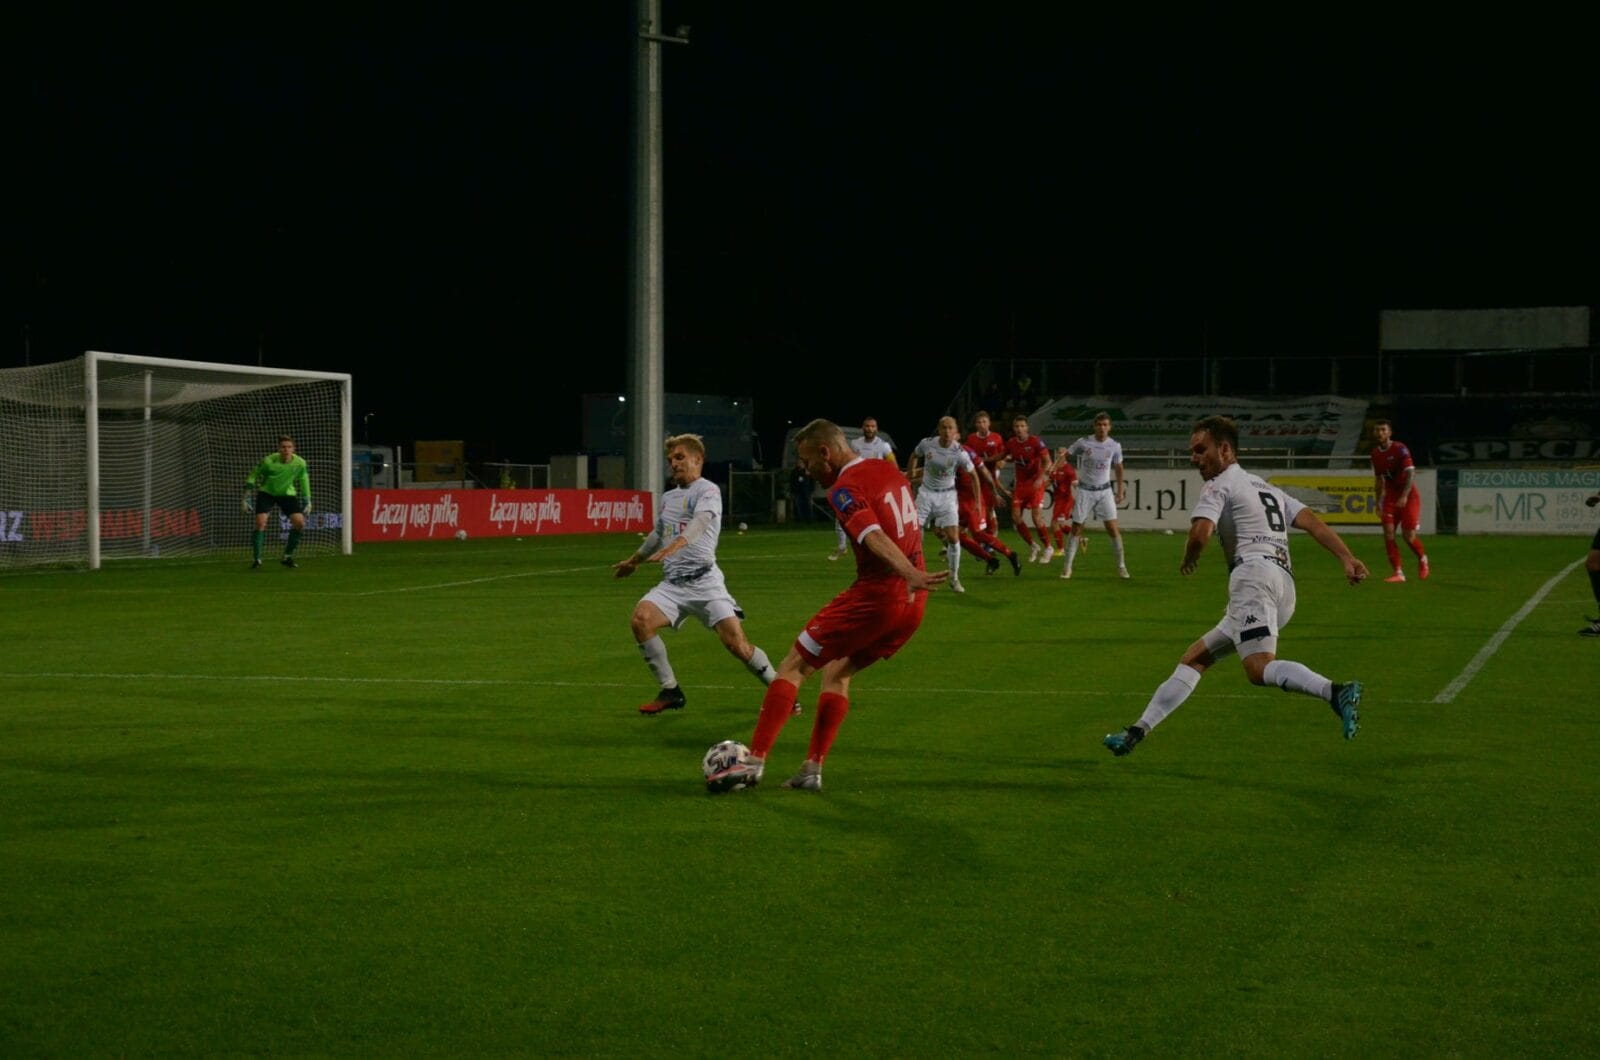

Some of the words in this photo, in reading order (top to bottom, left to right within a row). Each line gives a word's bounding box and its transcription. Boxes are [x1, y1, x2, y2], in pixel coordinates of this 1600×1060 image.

[1462, 472, 1550, 486] REZONANS
[410, 503, 432, 528] nas
[883, 485, 918, 539] 14
[1259, 492, 1286, 532] 8
[1495, 493, 1546, 521] MR
[29, 508, 202, 541] WSPMNENIA
